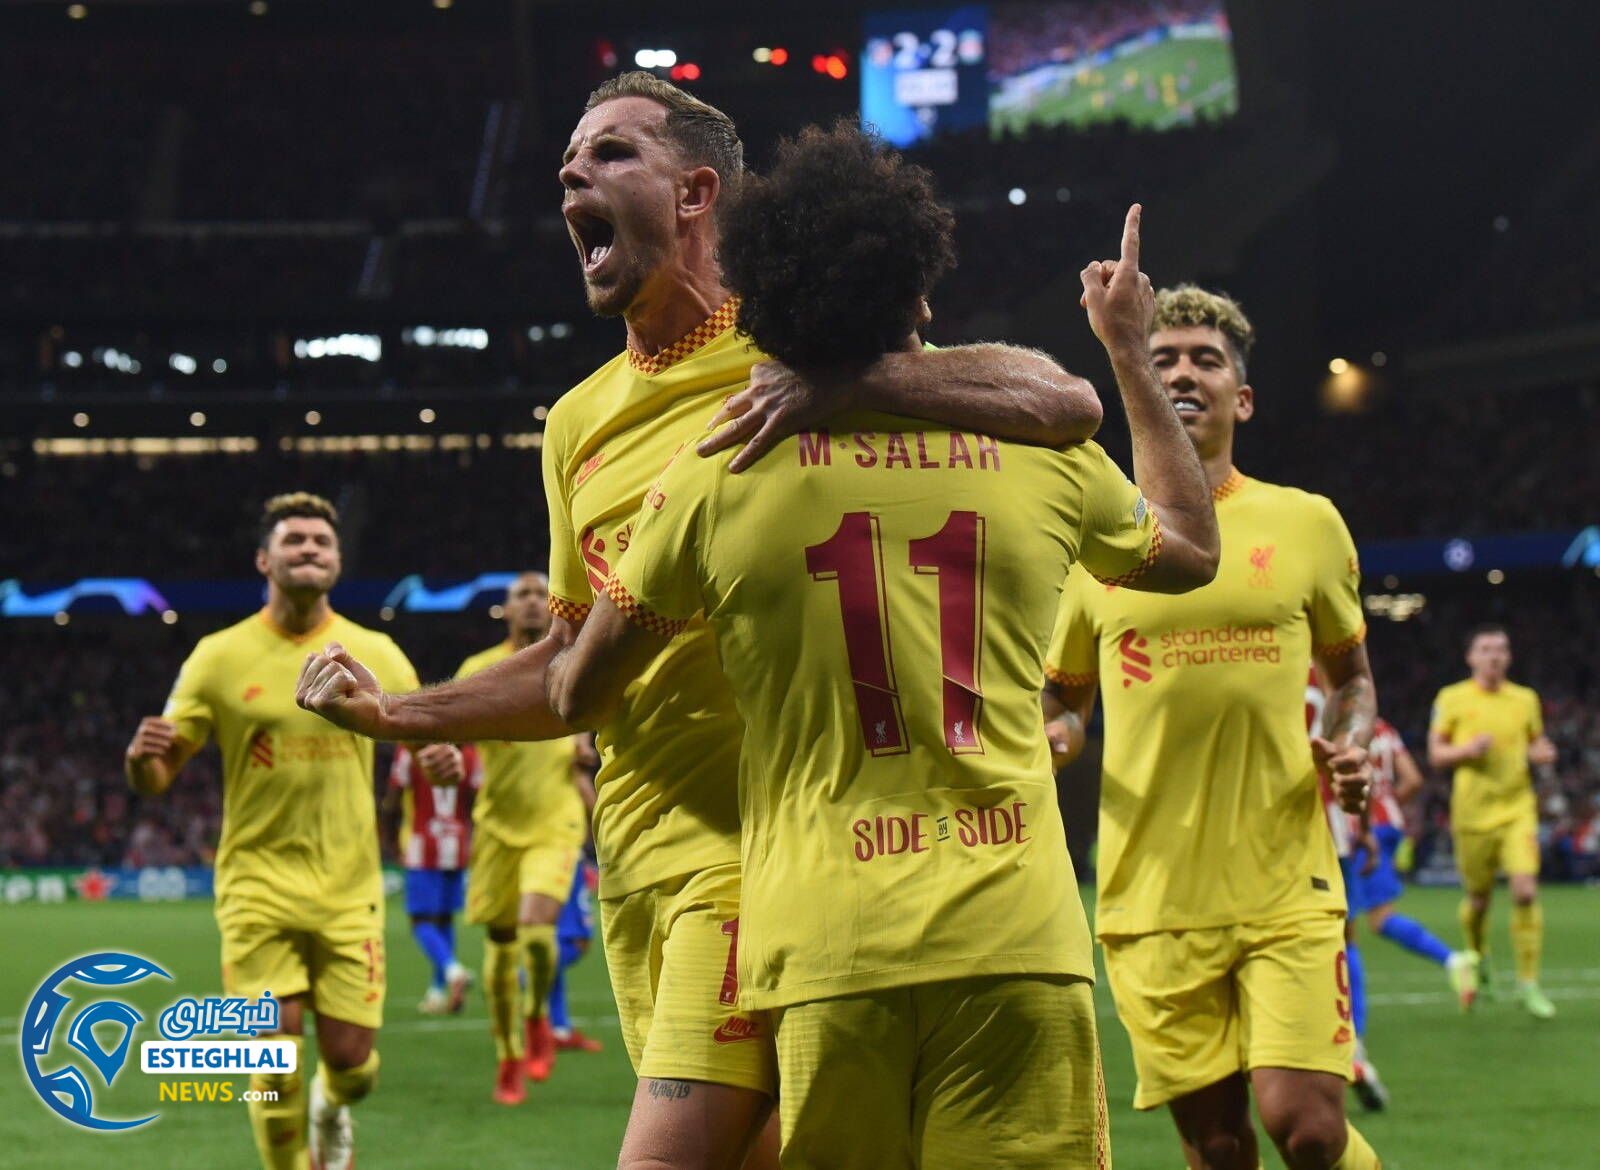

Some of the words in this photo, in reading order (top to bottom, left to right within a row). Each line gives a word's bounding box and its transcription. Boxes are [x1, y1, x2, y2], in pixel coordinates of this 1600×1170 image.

[804, 510, 986, 758] 11
[1160, 622, 1275, 649] standard
[1162, 645, 1281, 668] chartered
[852, 813, 930, 862] SIDE
[954, 802, 1032, 848] SIDE
